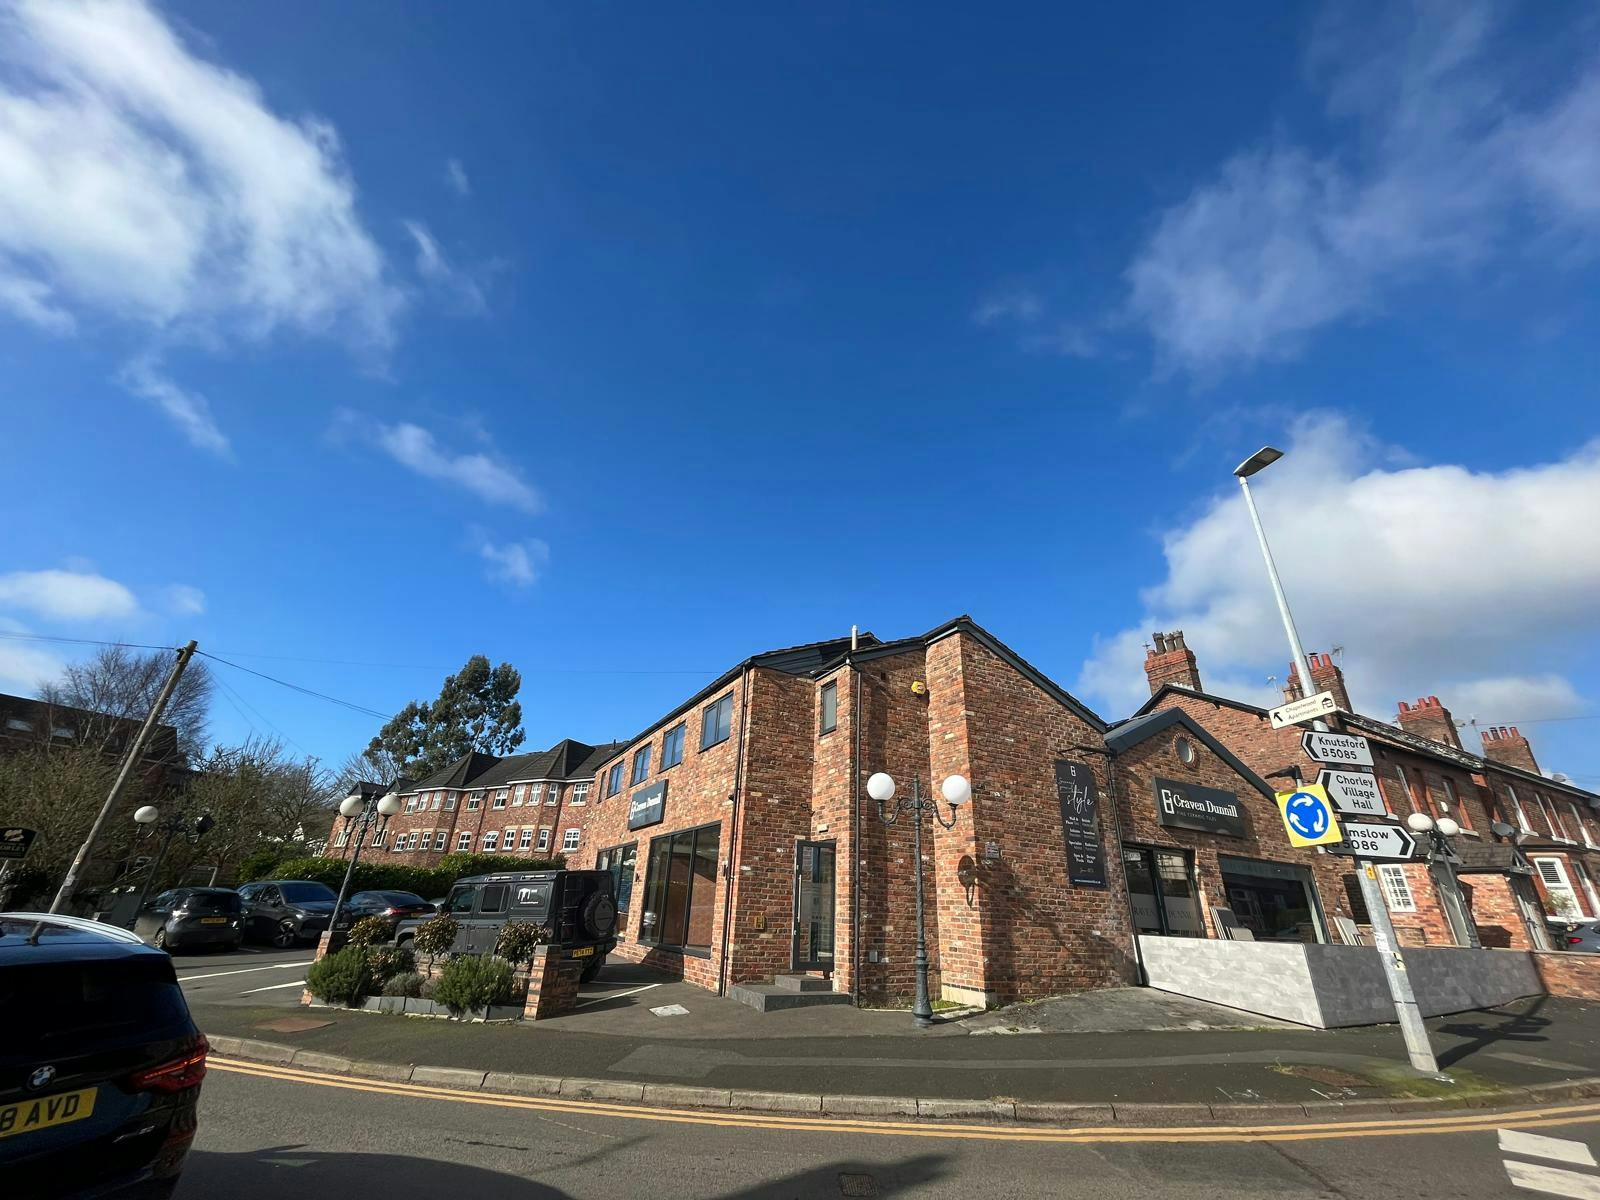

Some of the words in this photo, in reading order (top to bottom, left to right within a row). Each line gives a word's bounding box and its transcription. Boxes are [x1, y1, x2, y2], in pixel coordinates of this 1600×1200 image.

[1318, 736, 1365, 749] Knutsford
[1336, 775, 1373, 788] Chorley
[1341, 786, 1375, 799] Village
[1067, 785, 1095, 814] style
[1173, 794, 1206, 812] Craven
[1205, 800, 1239, 818] Dunnill
[1352, 799, 1374, 810] Hall
[1344, 827, 1389, 840] lmslow
[24, 1095, 80, 1127] AVD
